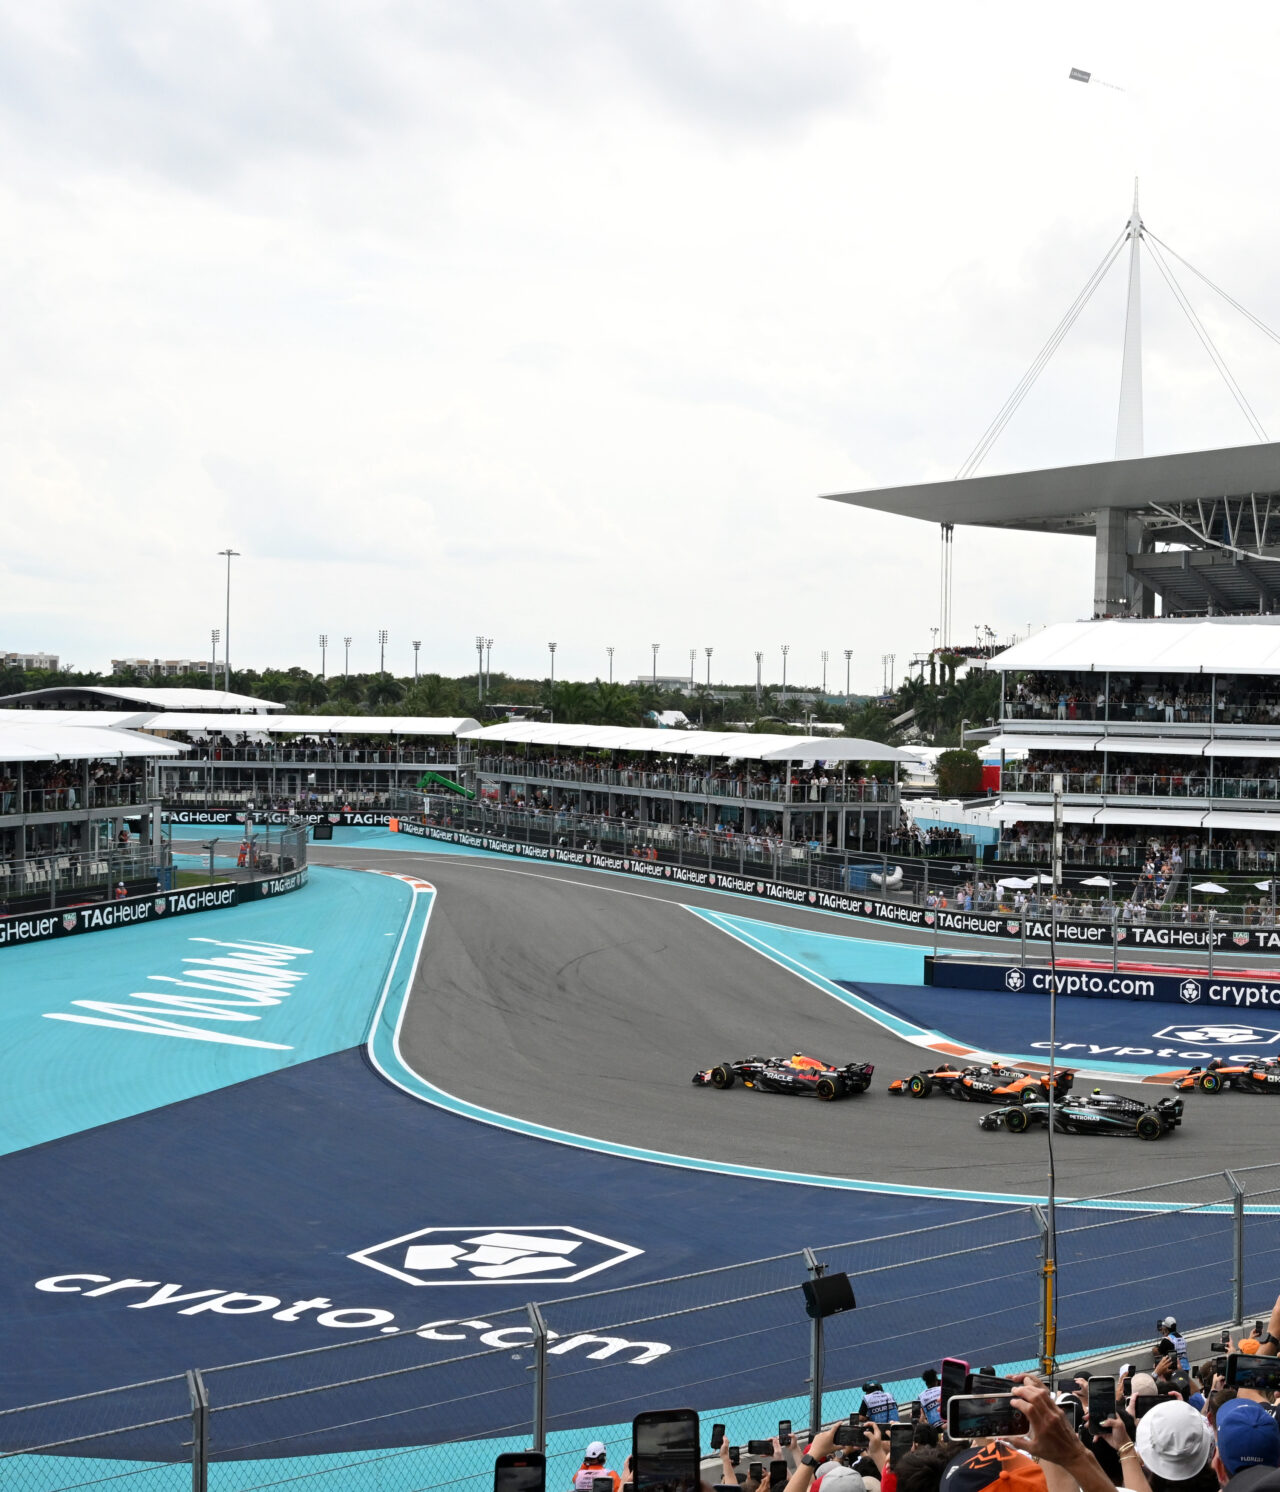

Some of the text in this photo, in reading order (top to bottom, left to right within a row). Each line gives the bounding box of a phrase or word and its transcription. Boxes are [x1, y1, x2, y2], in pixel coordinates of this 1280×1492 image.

[270, 876, 296, 893] TAGHeuer
[489, 839, 515, 853] TAGHeuer
[522, 845, 549, 858] TAGHeuer
[556, 850, 584, 863] TAGHeuer
[593, 854, 623, 869] TAGHeuer
[631, 861, 663, 876] TAGHeuer
[673, 868, 707, 884] TAGHeuer
[717, 875, 755, 892] TAGHeuer
[766, 883, 806, 902] TAGHeuer
[818, 893, 862, 913] TAGHeuer
[875, 903, 922, 923] TAGHeuer
[938, 912, 1002, 933] TAGHeuer
[1025, 922, 1105, 941] TAGHeuer
[1132, 928, 1226, 946] TAGHeuer
[81, 902, 151, 928] TAGHeuer
[169, 889, 235, 912] TAGHeuer
[1032, 973, 1154, 996] crypto.com
[763, 1071, 793, 1082] ORACLE
[999, 1069, 1025, 1079] Chrome
[1069, 1114, 1100, 1122] PETRONAS
[35, 1273, 671, 1365] crypto.com
